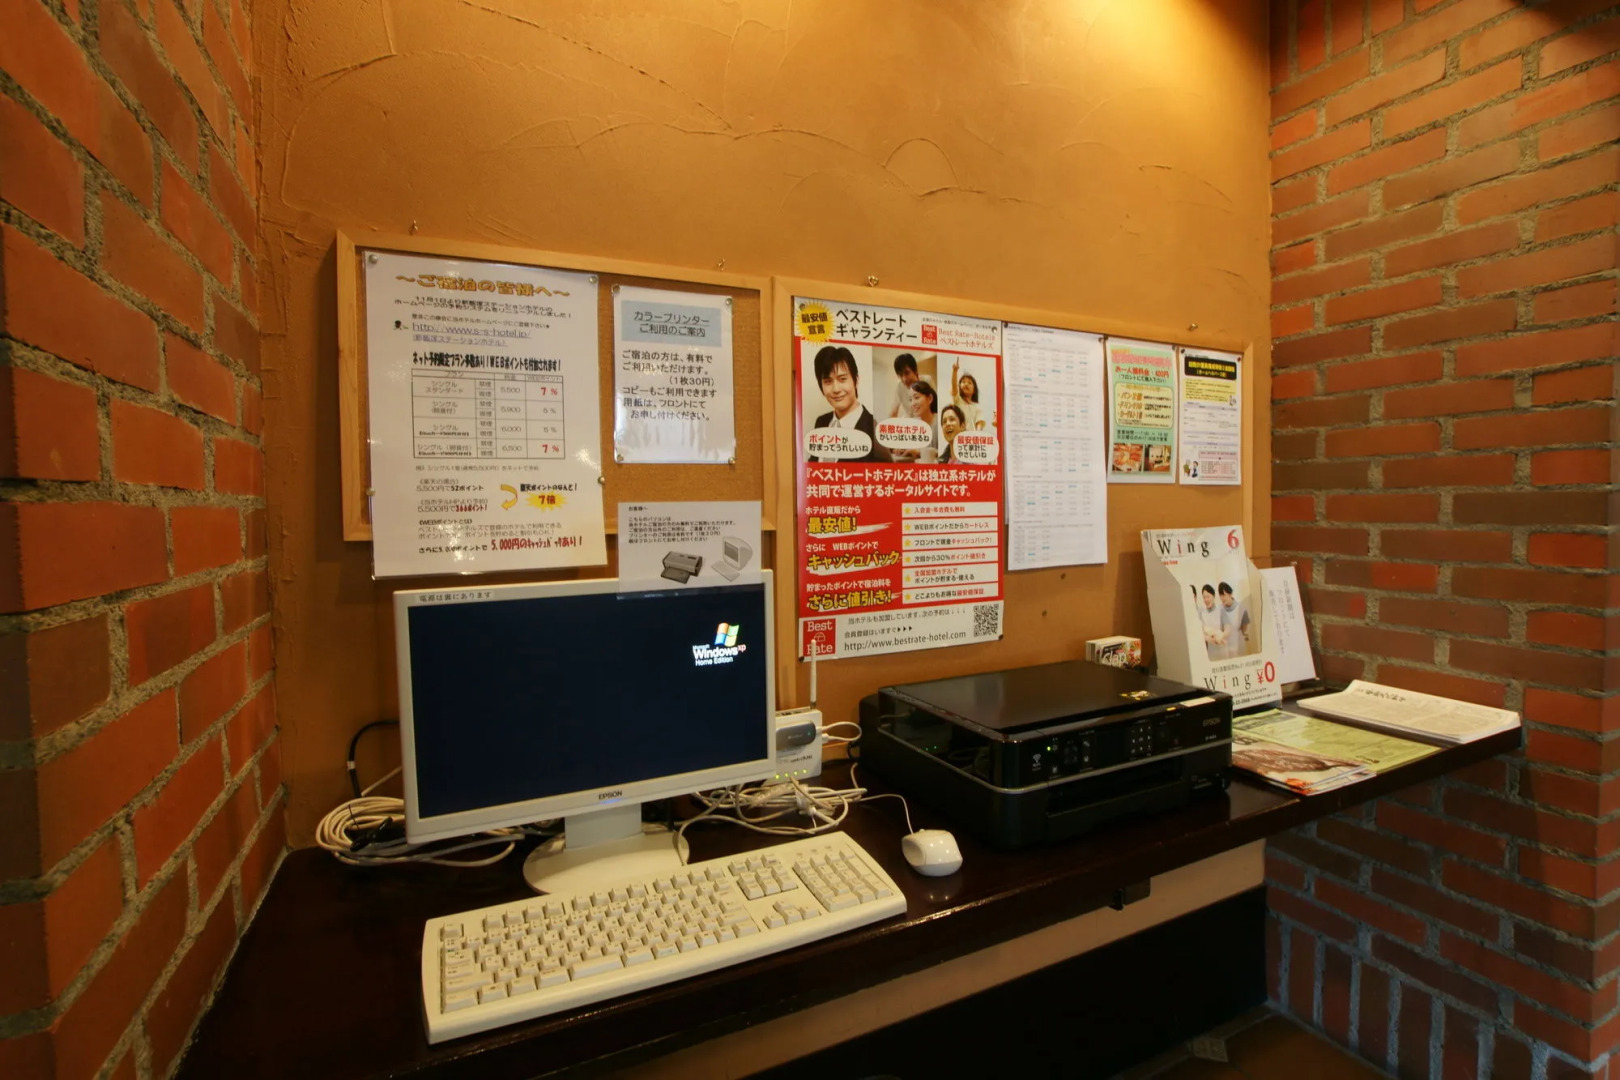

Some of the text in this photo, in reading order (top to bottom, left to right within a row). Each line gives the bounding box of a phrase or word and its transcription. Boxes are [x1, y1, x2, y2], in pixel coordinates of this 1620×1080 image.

[633, 311, 710, 326] カラープリンター
[801, 311, 829, 324] 最安値
[836, 308, 907, 328] ベストレート
[639, 323, 706, 338] ご利用のご案内
[807, 324, 826, 335] 宣言
[835, 323, 918, 343] ギャランティー
[940, 338, 994, 349] ベストレートホテルズ
[622, 350, 713, 364] ご宿泊の方は、有料で
[622, 361, 709, 376] ご利用いただけます。
[668, 376, 715, 387] （1枚30円）
[540, 387, 559, 396] 7 %
[622, 386, 718, 398] コピーもご利用できます
[623, 397, 706, 409] 用紙は、フロントにて
[630, 409, 710, 421] お申し付けください。
[879, 424, 927, 434] 素敵なホテル
[809, 434, 848, 444] ポイントが
[879, 432, 929, 442] がいっぱいあるね
[957, 436, 994, 445] 最安値保証
[541, 444, 560, 453] 7 %
[809, 442, 869, 453] 貯まってうれしいね
[957, 451, 987, 459] やさしいね
[807, 468, 996, 483] 『ベストレートホテルズ』は独立系ホテルが
[806, 484, 971, 499] 共同で運営するポータルサイトです。
[538, 494, 556, 505] 7倍
[805, 505, 861, 515] ホテル直販だから
[807, 516, 857, 535] 最安値！
[805, 541, 879, 552] さらに WEBポイントで
[1157, 529, 1240, 558] Wing 6
[807, 551, 900, 571] キャッシュバック
[806, 578, 891, 592] 貯まったポイントで宿泊料を
[419, 592, 492, 602] 電源は裏にあります
[807, 590, 892, 611] さらに値引き！
[806, 620, 833, 633] Best
[844, 631, 967, 652] http://www.bestrate-hotel.com
[692, 647, 739, 660] Windows
[695, 656, 734, 667] Home Edition
[1203, 673, 1251, 691] Wing
[598, 790, 623, 801] EPSON
